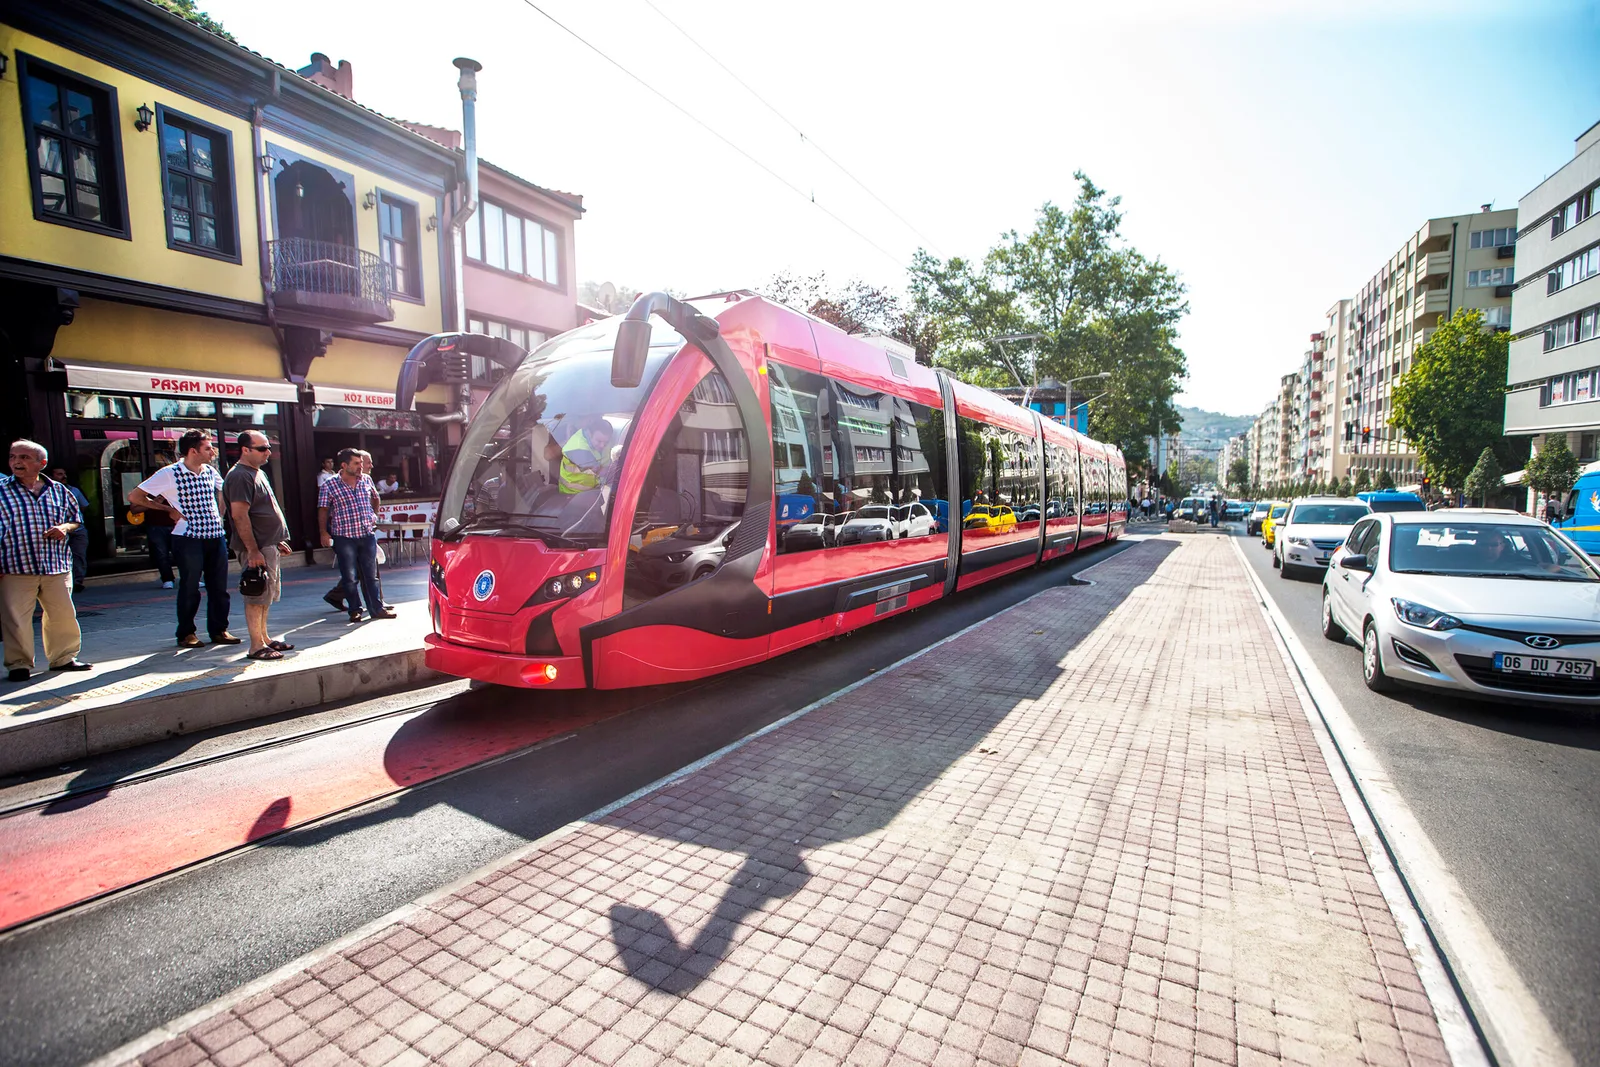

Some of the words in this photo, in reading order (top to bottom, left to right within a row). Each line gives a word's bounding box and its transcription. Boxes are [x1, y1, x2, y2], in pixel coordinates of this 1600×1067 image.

[150, 378, 200, 393] PAŞAM
[205, 382, 244, 395] MODA
[344, 392, 362, 403] KÖZ
[365, 395, 394, 405] KEBAP
[1503, 656, 1521, 669] 06
[1530, 658, 1549, 671] DU
[1555, 660, 1592, 675] 7957
